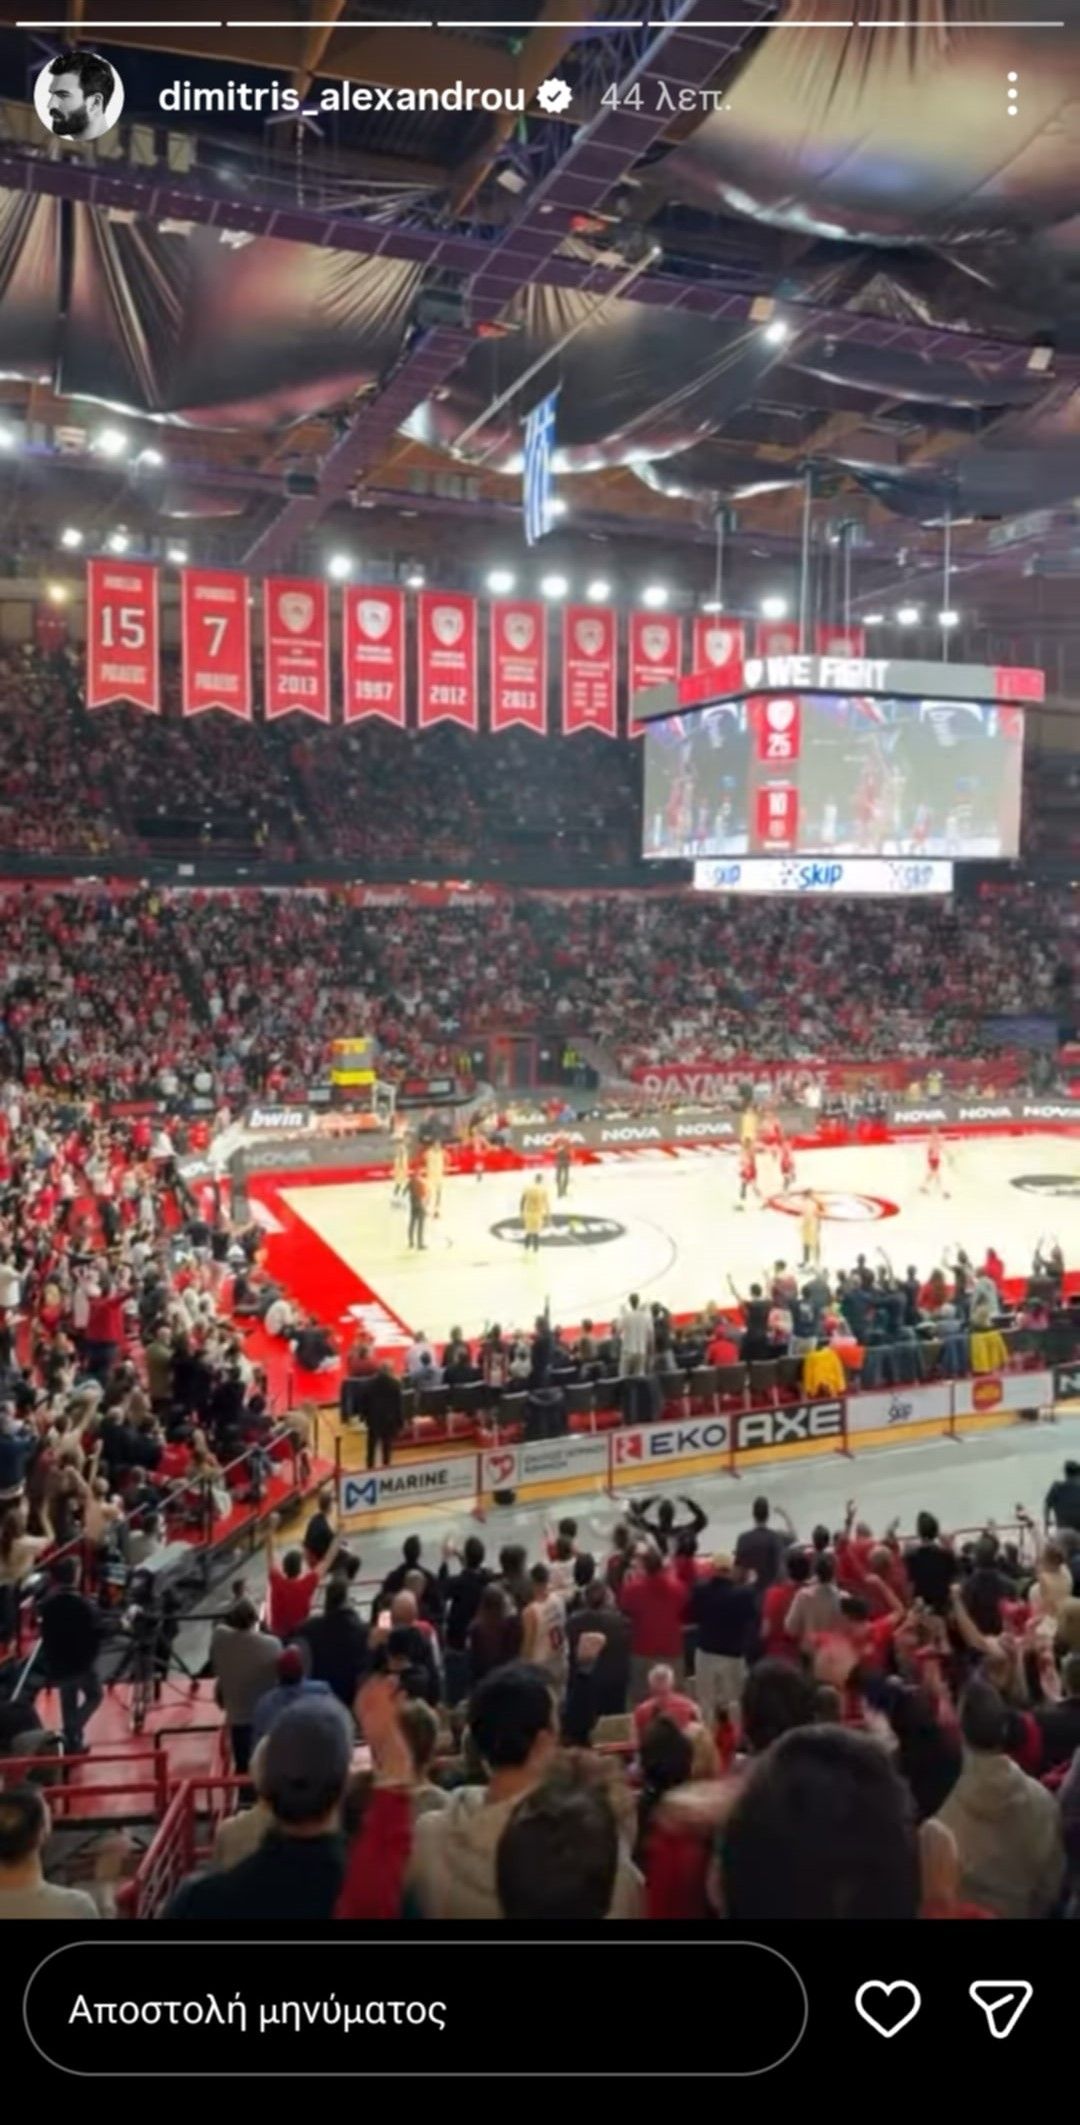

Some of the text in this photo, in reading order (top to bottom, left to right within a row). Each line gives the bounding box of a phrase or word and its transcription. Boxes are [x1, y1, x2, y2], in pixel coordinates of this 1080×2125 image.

[101, 605, 146, 648] 15
[203, 615, 228, 657] 7
[767, 657, 812, 688] WE
[249, 1108, 302, 1128] bwin
[894, 1107, 947, 1124] NOVA
[959, 1104, 1013, 1120] NOVA
[601, 1126, 661, 1142] NOVA
[675, 1121, 734, 1137] NOVA
[737, 1402, 842, 1449] AXE
[650, 1423, 727, 1456] EKO
[379, 1468, 448, 1493] MARINE
